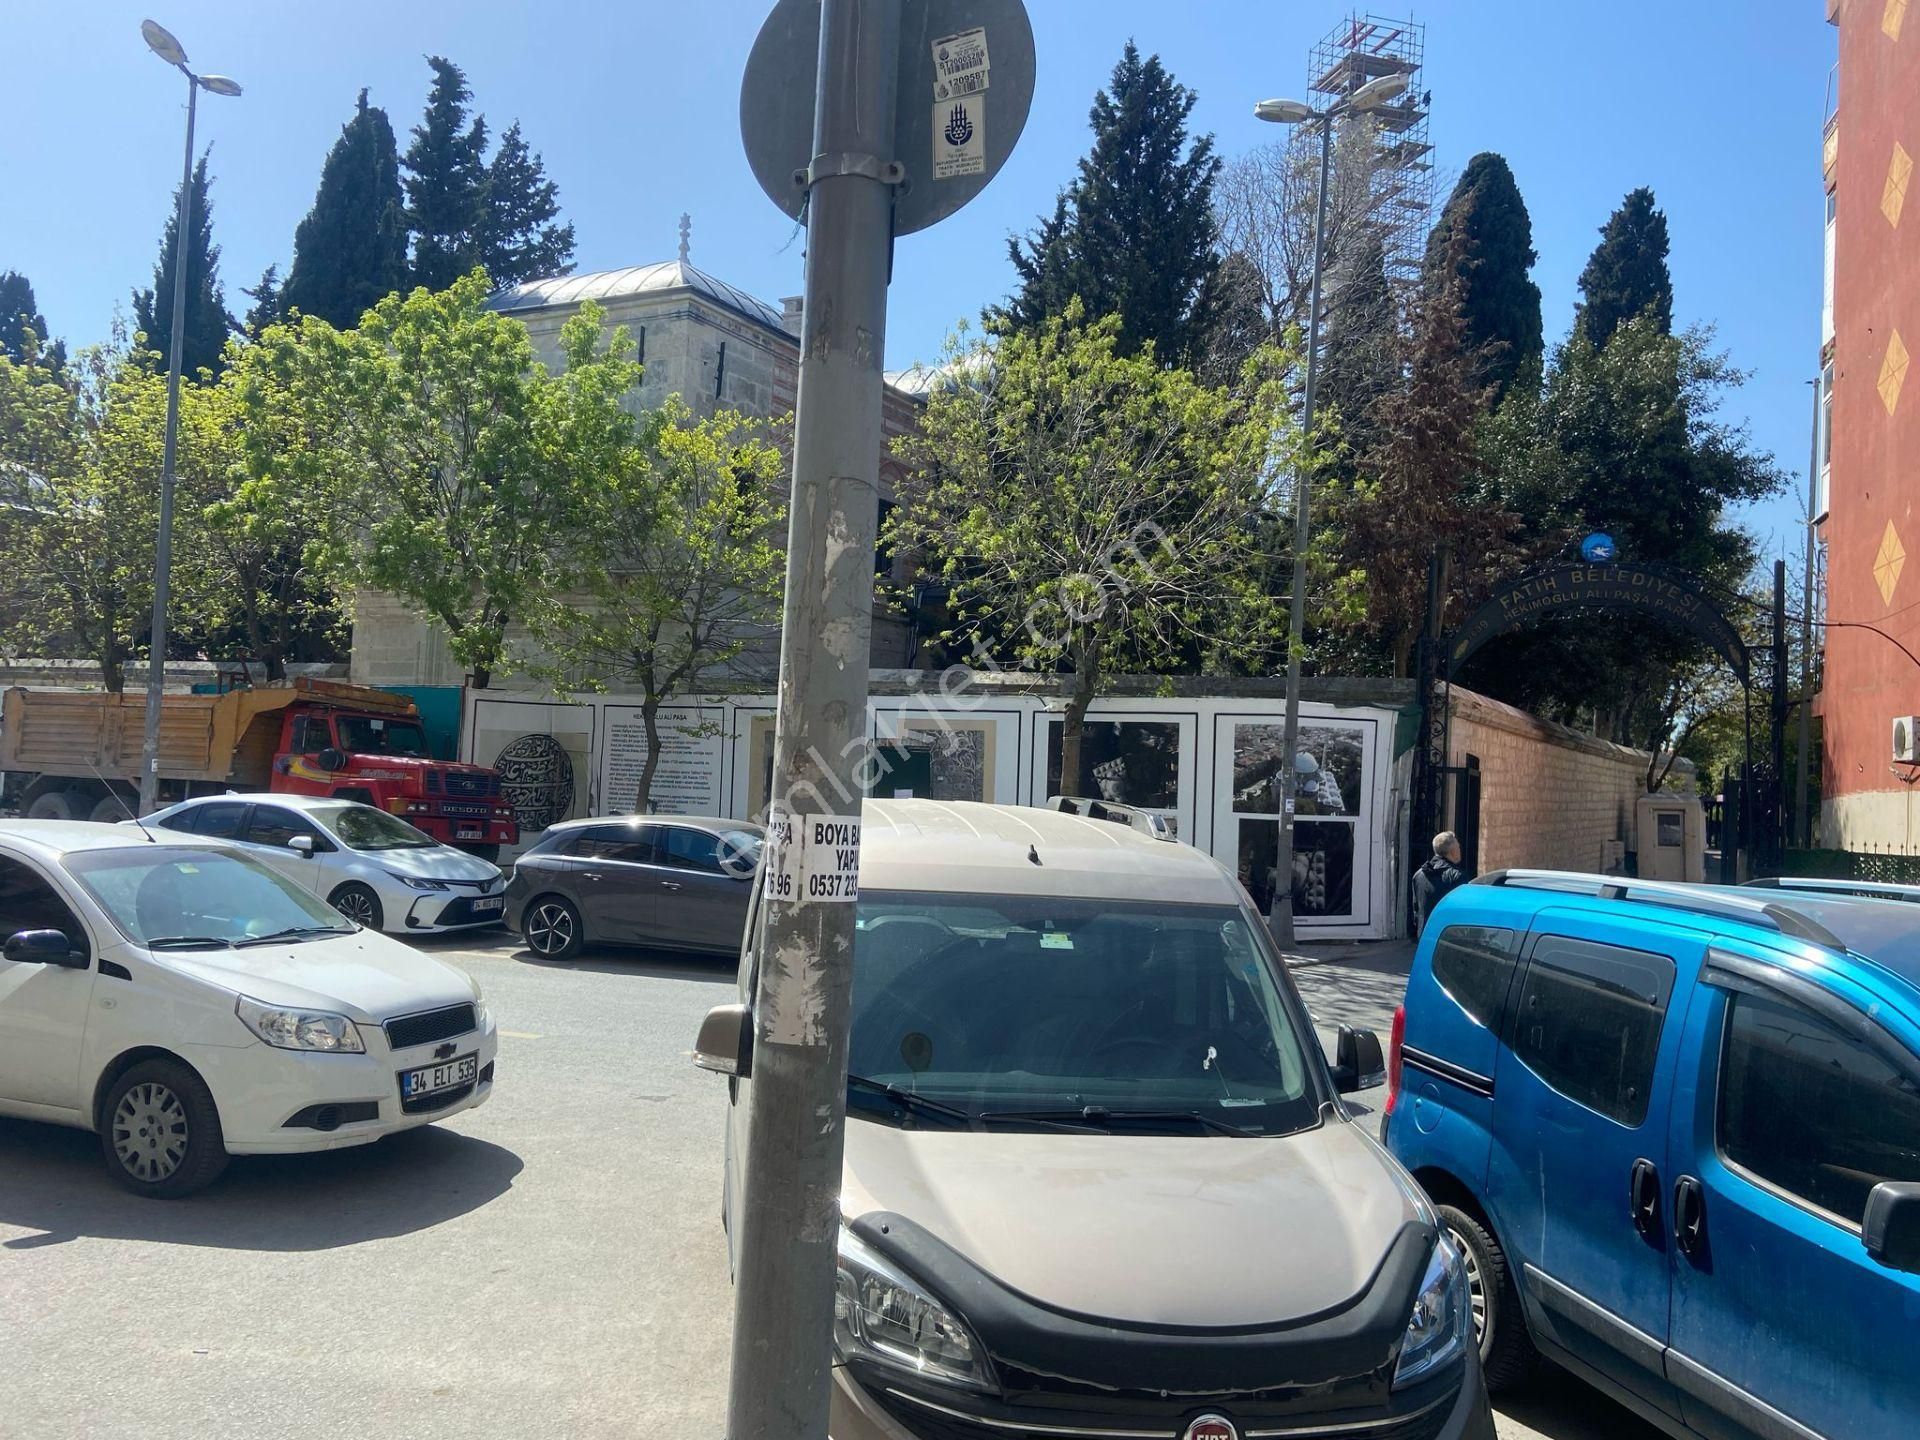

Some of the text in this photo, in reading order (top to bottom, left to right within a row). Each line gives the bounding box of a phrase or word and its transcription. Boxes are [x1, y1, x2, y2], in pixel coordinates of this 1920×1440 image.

[815, 823, 848, 846] BOYA
[777, 874, 791, 896] 96
[810, 874, 842, 896] 0537
[412, 1072, 427, 1092] 34
[434, 1065, 453, 1087] ELT
[458, 1059, 475, 1080] 535
